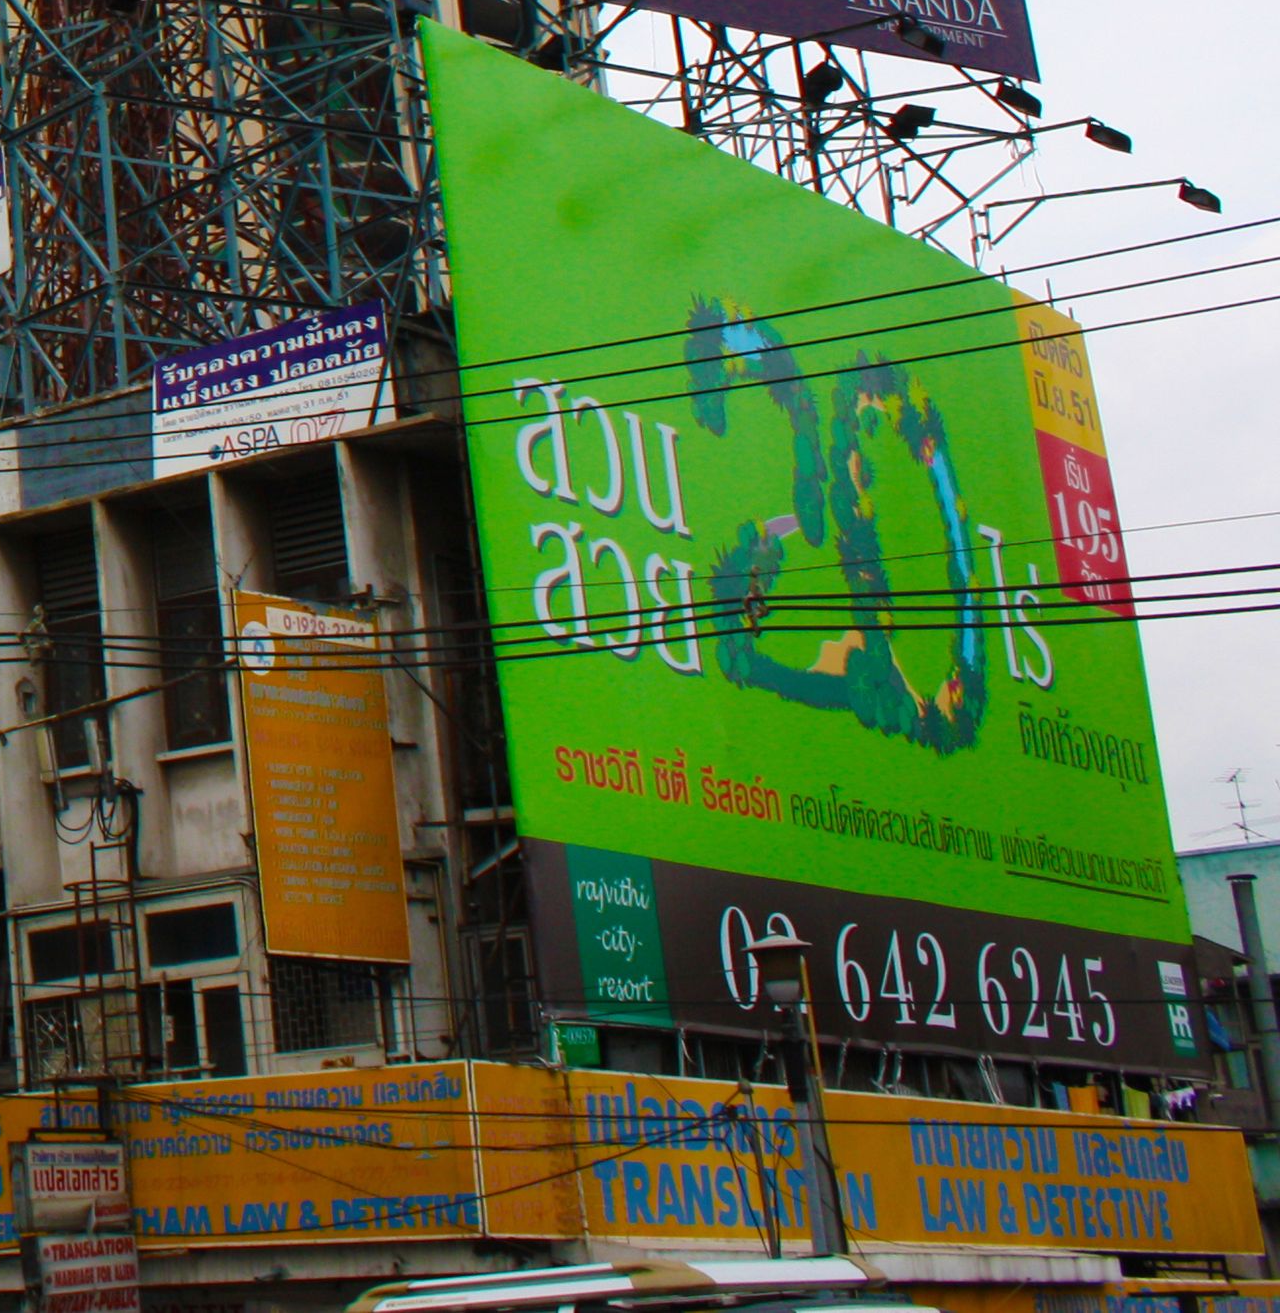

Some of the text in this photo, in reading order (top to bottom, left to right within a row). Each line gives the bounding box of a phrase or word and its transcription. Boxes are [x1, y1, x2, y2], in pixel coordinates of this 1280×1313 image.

[161, 315, 378, 386] รับรองความมั่นคง
[162, 372, 260, 411] แข็งแรง
[270, 338, 381, 383] ปลอดภัย
[220, 425, 281, 462] ASPA
[512, 378, 693, 540] สวน
[1063, 447, 1090, 492] เริ่ม
[1053, 491, 1118, 563] 1.95
[530, 521, 704, 678] สวย
[976, 523, 1054, 689] ไร่
[1018, 700, 1148, 793] ติดห้องคุณ
[555, 746, 643, 796] ราชวิถี
[653, 748, 690, 806] ซิตี้
[700, 765, 782, 823] รีสอร์ท
[577, 877, 650, 913] rajvithi
[598, 975, 654, 1002] resort
[837, 922, 957, 1029] 642
[977, 942, 1116, 1047] 6245
[33, 1166, 119, 1192] แปลเอกสาร
[909, 1118, 1059, 1175] ทนายความ
[1073, 1120, 1189, 1184] และนักสืบ
[224, 1202, 288, 1234] LAW
[299, 1199, 320, 1230] &
[332, 1193, 480, 1230] DETECTIVE
[918, 1177, 987, 1234] LAW
[999, 1182, 1018, 1234] &
[1024, 1182, 1173, 1241] DETECTIVE
[51, 1237, 134, 1261] TRANSLATION
[97, 1266, 112, 1282] FOR
